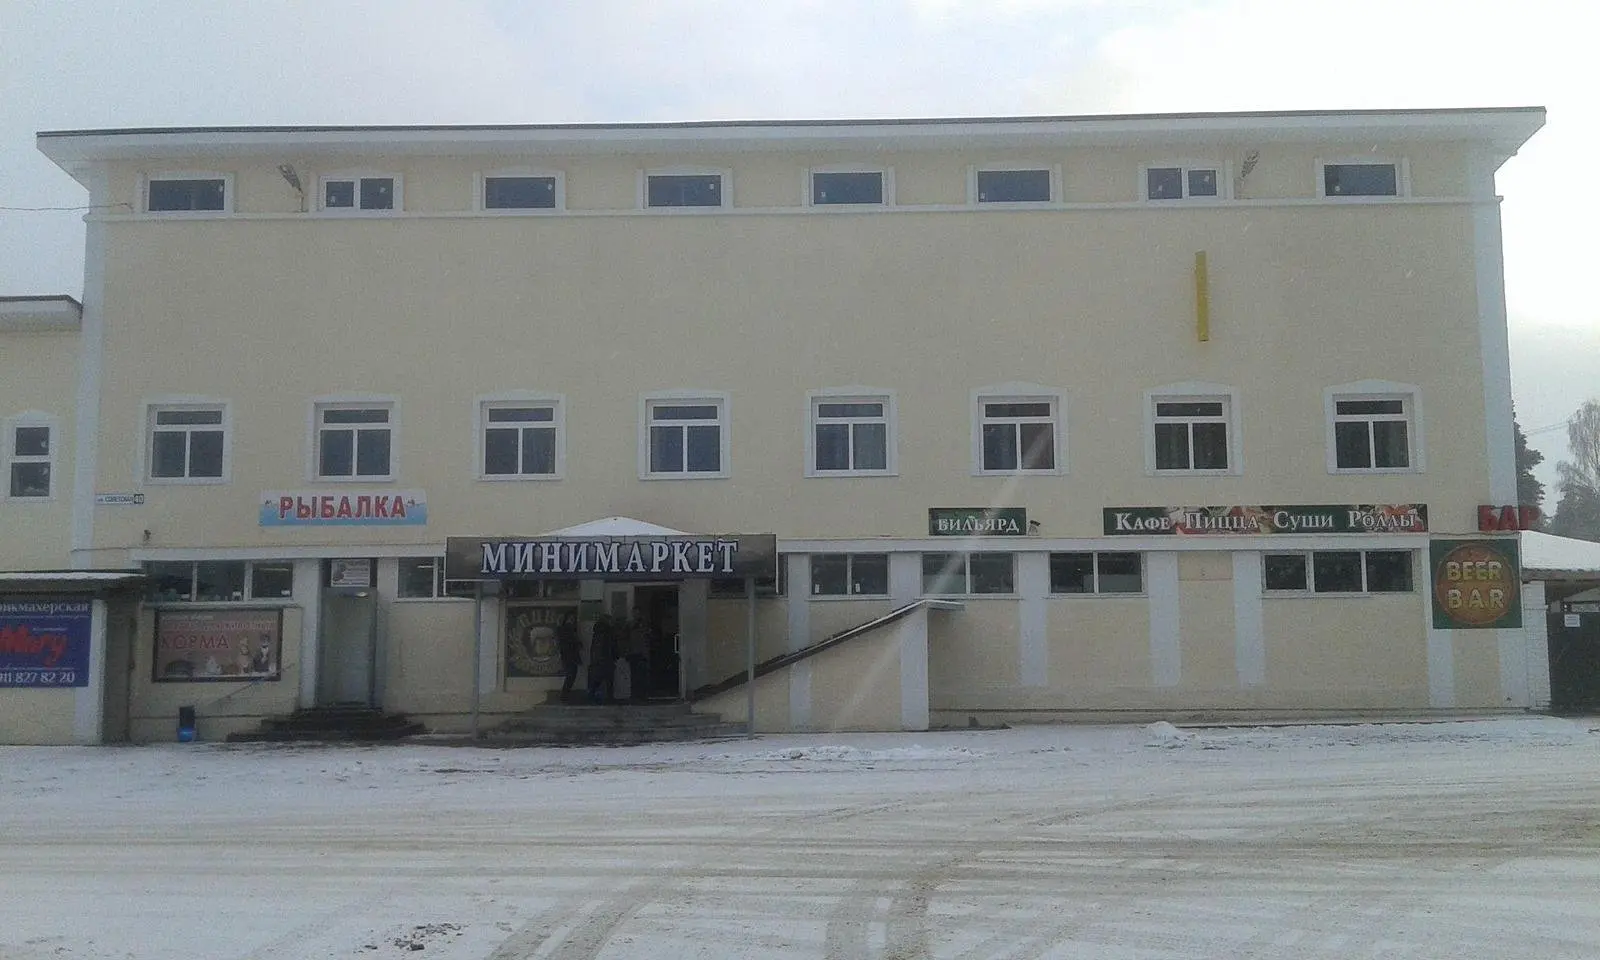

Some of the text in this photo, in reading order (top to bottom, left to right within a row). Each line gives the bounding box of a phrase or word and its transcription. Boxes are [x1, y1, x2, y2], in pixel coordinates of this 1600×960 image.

[279, 495, 406, 518] РЫБАЛКА
[937, 518, 1020, 533] БИЛЬЯРД
[1478, 505, 1540, 531] БАР
[481, 540, 739, 574] МИНИМАРКЕТ
[1447, 561, 1502, 580] BEER
[1448, 588, 1504, 609] BAR
[40, 671, 56, 683] 82
[60, 671, 76, 683] 20
